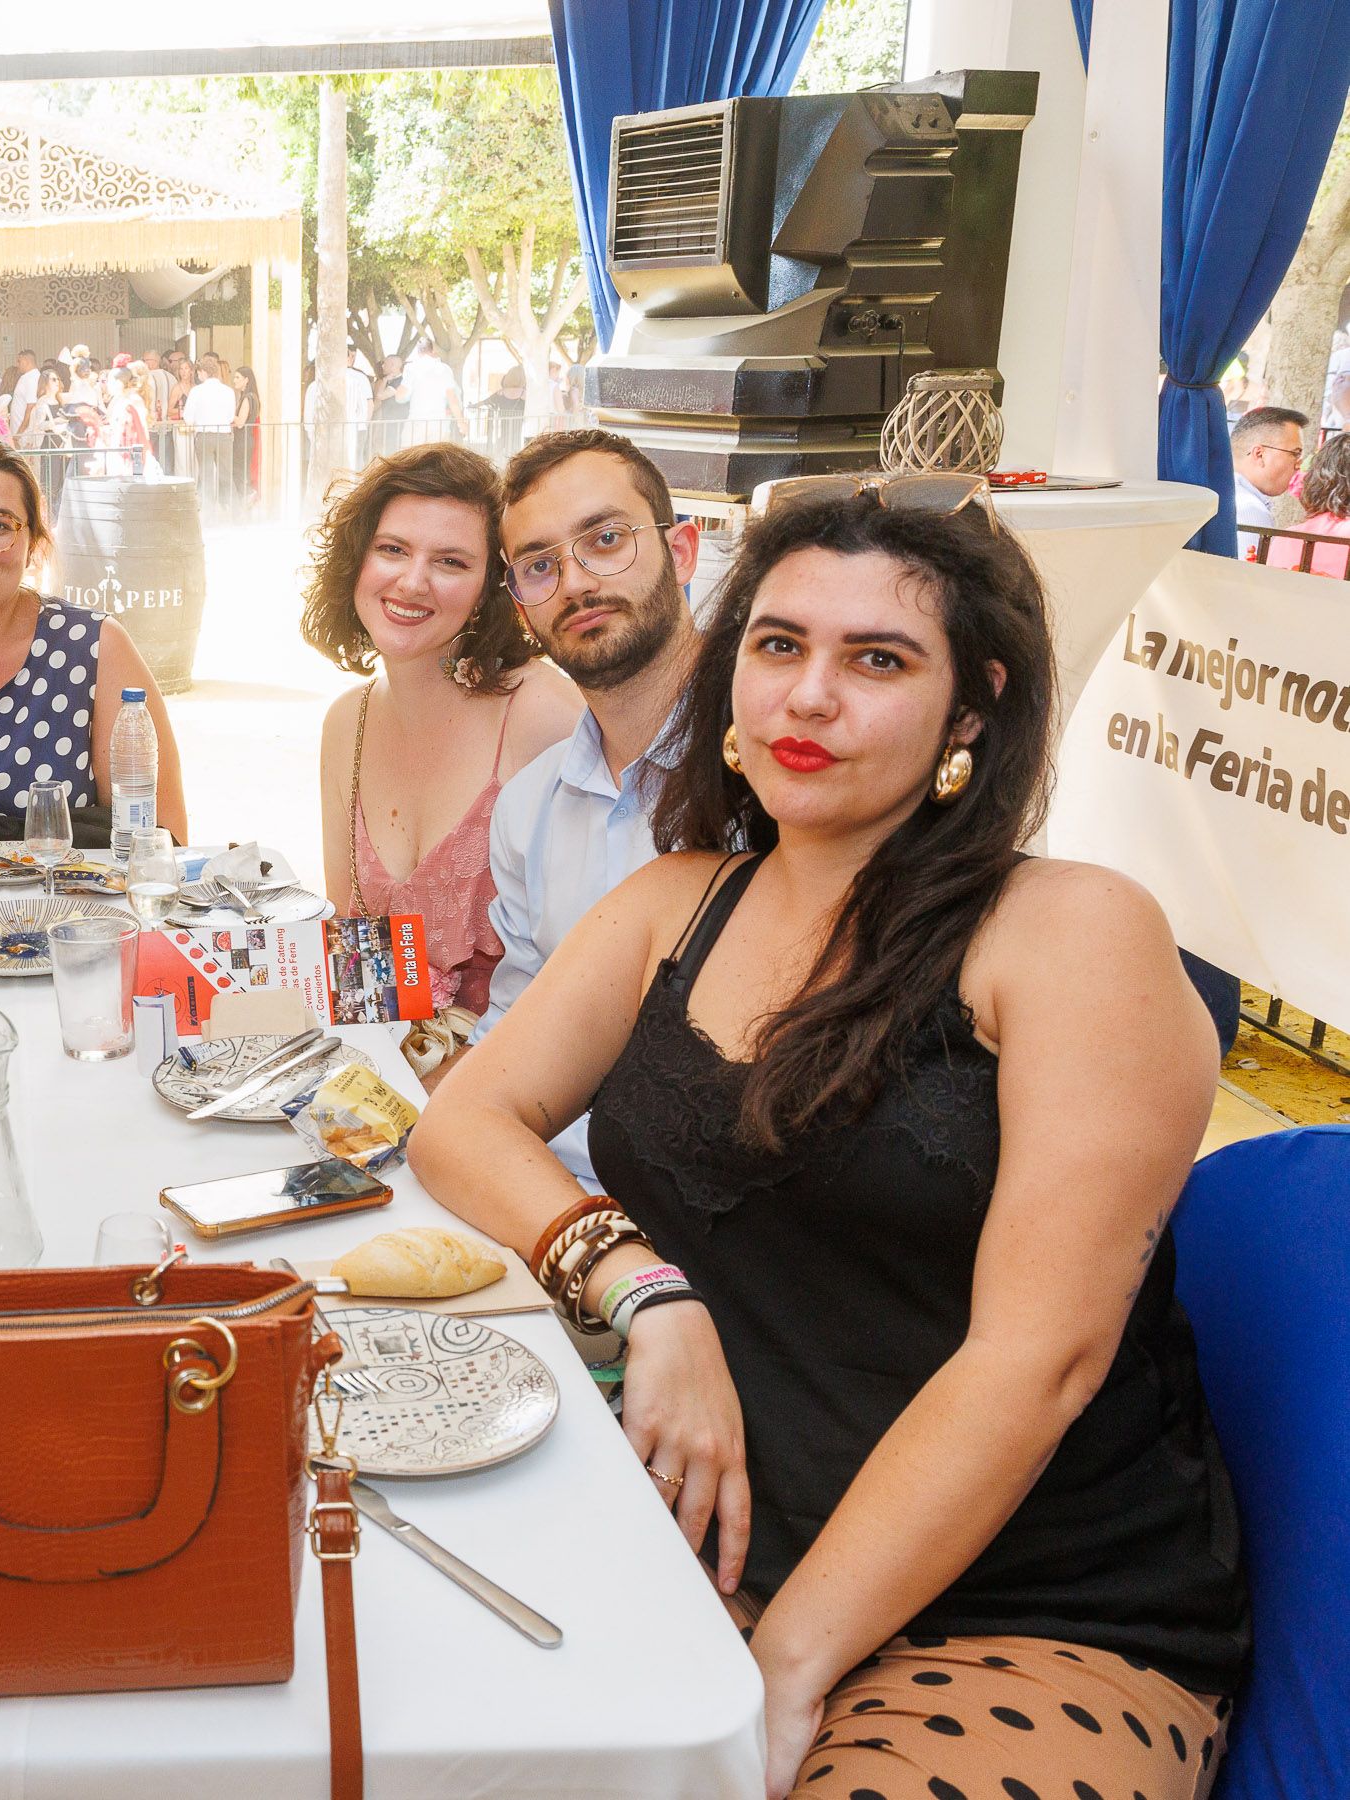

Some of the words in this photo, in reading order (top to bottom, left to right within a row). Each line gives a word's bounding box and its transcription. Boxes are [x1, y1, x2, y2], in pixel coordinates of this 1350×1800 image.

[126, 589, 183, 608] PEPE
[1123, 613, 1168, 671] La
[1166, 637, 1280, 711] mejor
[1279, 670, 1350, 732] not
[1107, 712, 1151, 759] en
[1154, 712, 1180, 773] la
[1184, 728, 1293, 814] Feria
[1300, 767, 1350, 835] de
[276, 928, 286, 964] Catering
[398, 923, 415, 946] Feria
[288, 942, 298, 964] Feria
[401, 947, 416, 959] de
[279, 966, 287, 977] de
[290, 965, 299, 977] de
[403, 961, 419, 986] Carta
[314, 964, 325, 1011] Conciertos
